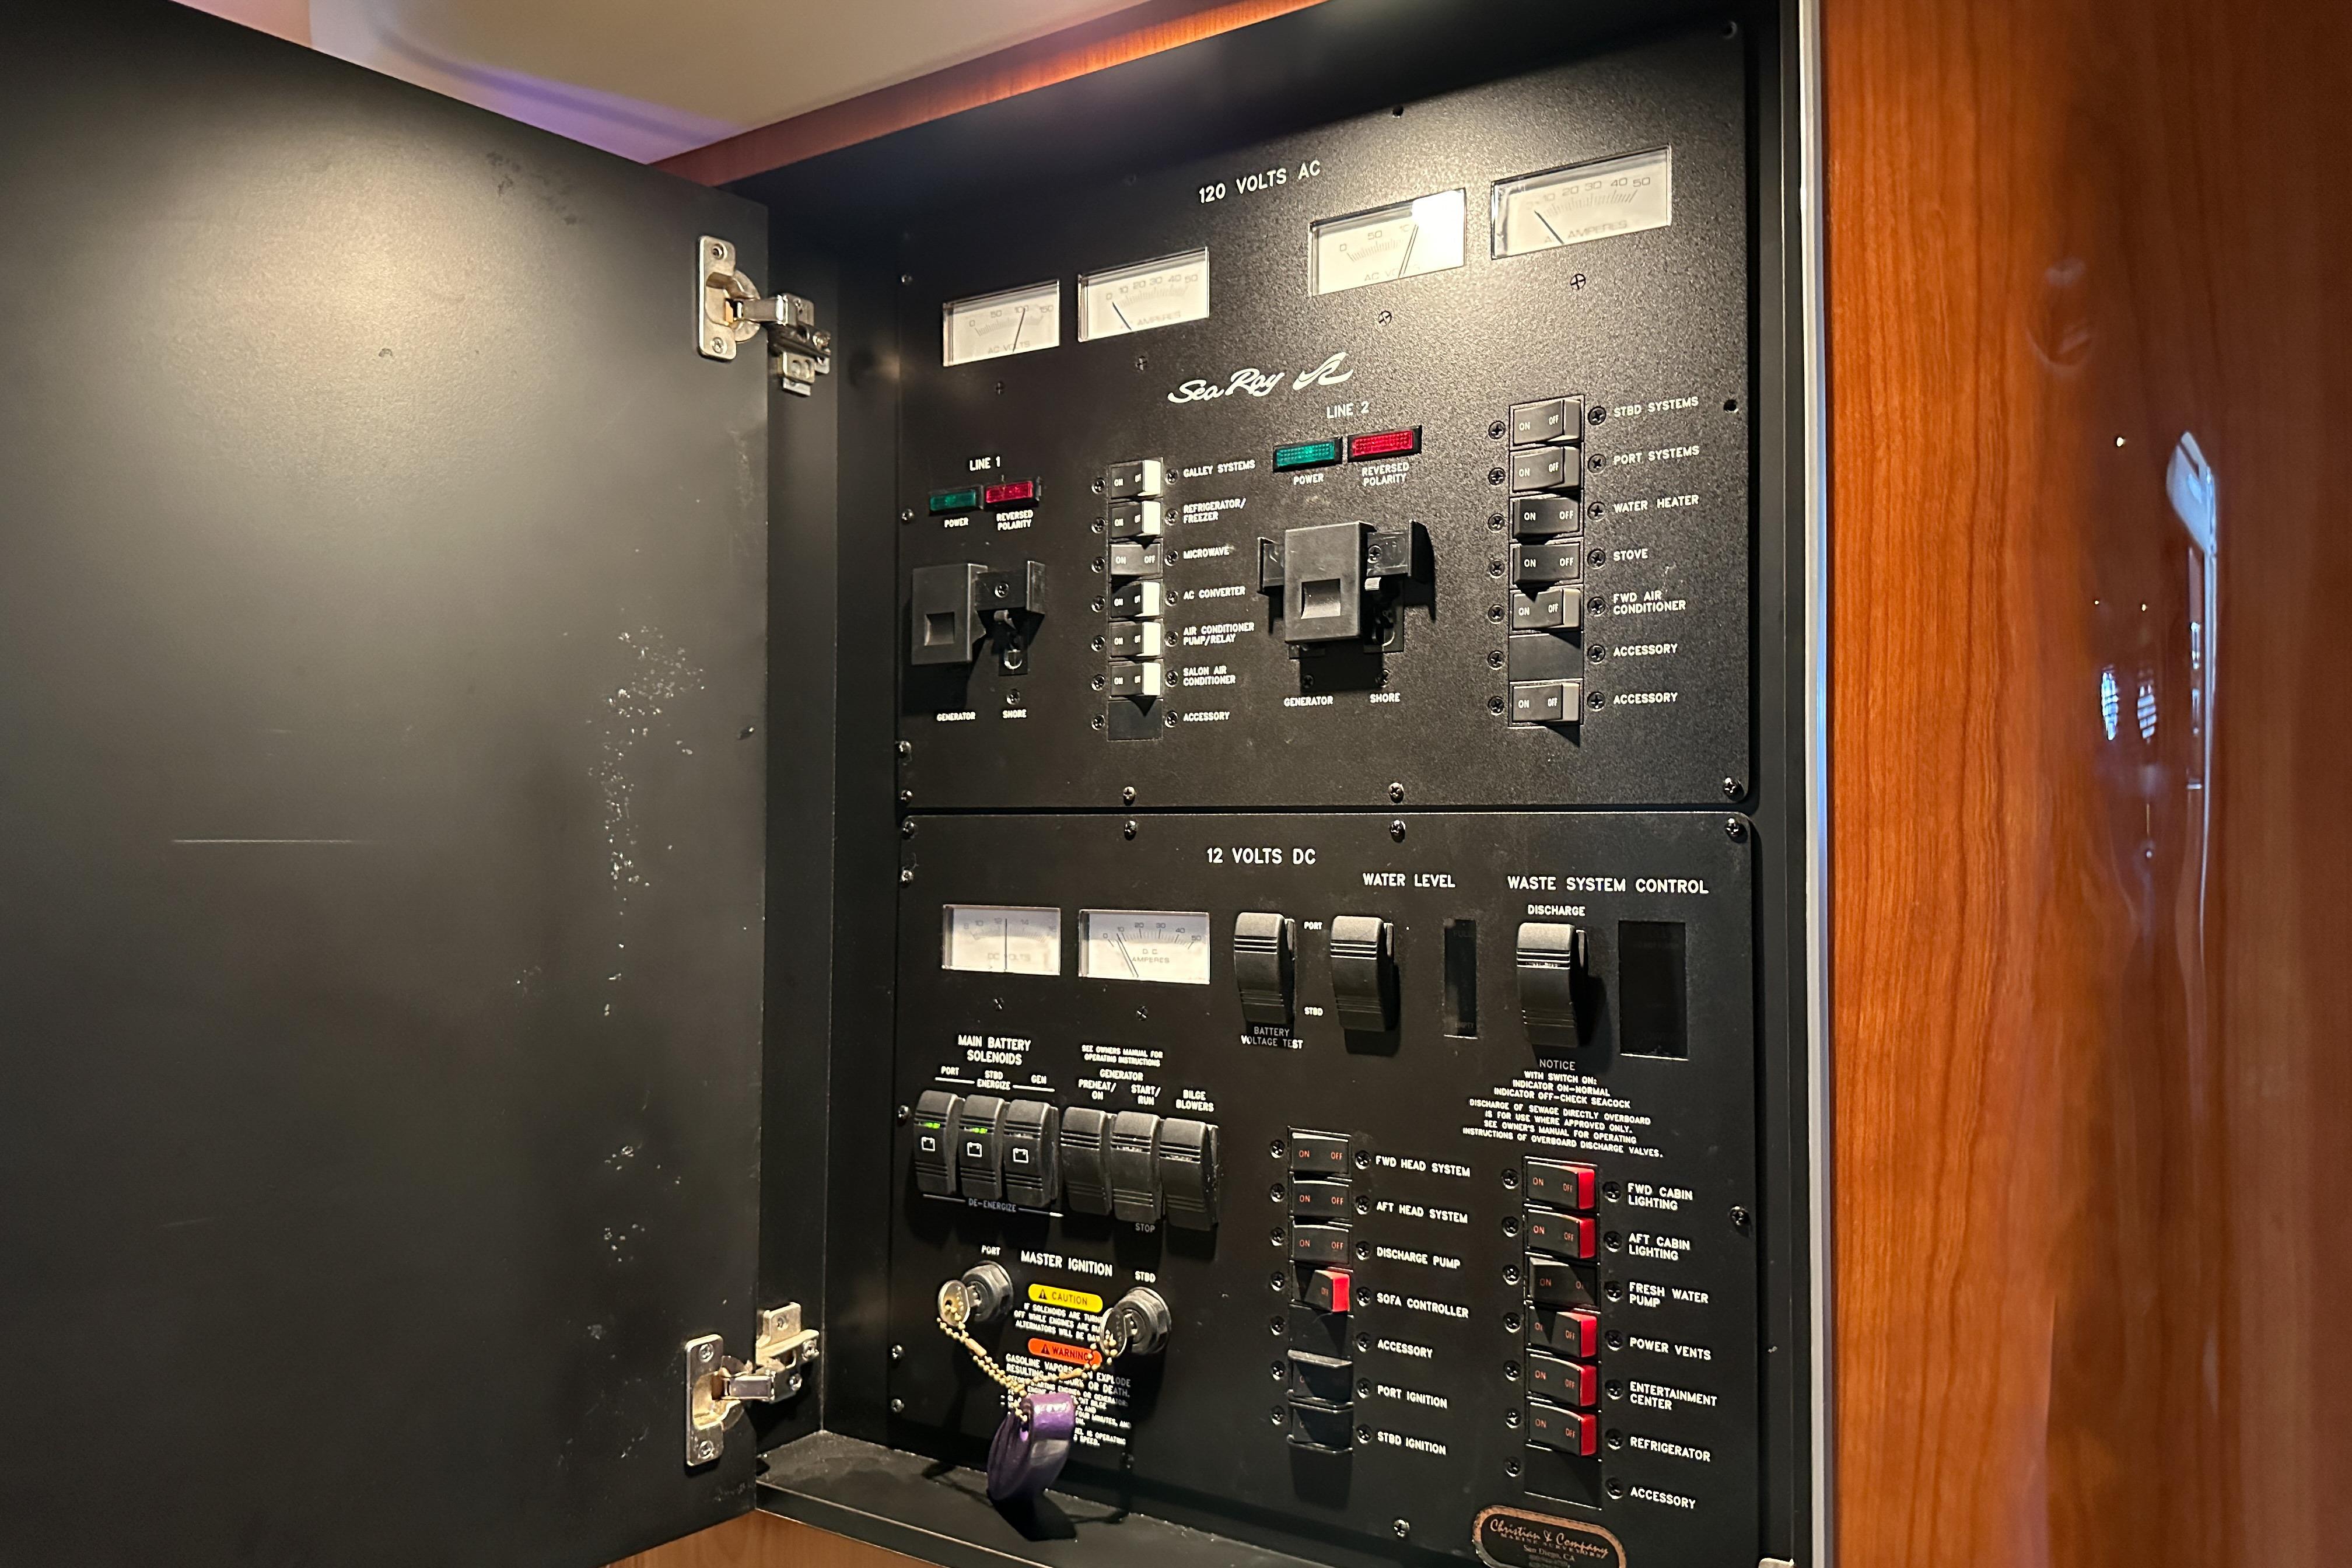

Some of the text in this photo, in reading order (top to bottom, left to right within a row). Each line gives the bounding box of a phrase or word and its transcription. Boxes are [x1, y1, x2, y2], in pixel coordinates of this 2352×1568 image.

[1199, 160, 1321, 203] 120 VOLTS AC
[1611, 177, 1650, 187] 40 50
[1168, 368, 1284, 403] Sea Ray
[1327, 402, 1369, 418] LINE 2
[1614, 397, 1699, 418] STBD SYSTEMS
[1614, 446, 1699, 466] PORT SYSTEMS
[970, 457, 1001, 471] LINE 1
[1184, 460, 1255, 478] GALLEY SYSTEMS
[1362, 463, 1409, 477] REVERSED
[1294, 474, 1324, 485] POWER
[1363, 473, 1407, 486] POLARITY
[1184, 498, 1247, 513] REFRIGERATOR/
[1614, 495, 1699, 513] WATER HEATER
[944, 518, 968, 527] POWER
[997, 510, 1033, 522] REVERSED
[1184, 511, 1219, 524] FREEZER
[1524, 510, 1573, 521] ON OFF
[998, 519, 1031, 530] POLARITY
[1184, 547, 1229, 559] MICROWAVE
[1614, 549, 1648, 561] STOVE
[1184, 586, 1245, 600] AC CONVERTER
[1614, 590, 1662, 603] FWD AIR
[1614, 600, 1686, 615] CONDITIONER
[1184, 622, 1255, 635] AIR CONDITIONER
[1184, 634, 1236, 646] PUMP/RELAY
[1614, 644, 1678, 657] ACCESSORY
[1184, 666, 1227, 676] SALON AIR
[1184, 675, 1236, 685] CONDITIONER
[1284, 696, 1334, 706] GENERATOR
[1370, 692, 1400, 704] SHORE
[1614, 692, 1678, 705] ACCESSORY
[937, 712, 975, 722] GENERATOR
[1003, 710, 1027, 718] SHORE
[1184, 712, 1230, 722] ACCESSORY
[1207, 848, 1316, 864] 12 VOLTS DC
[1363, 873, 1455, 888] WATER LEVEL
[1508, 876, 1709, 894] WASTE SYSTEM CONTROL
[1528, 905, 1585, 916] DISCHARGE
[1304, 922, 1322, 930] PORT
[1304, 1007, 1323, 1016] STBD
[1254, 1027, 1290, 1036] BATTERY
[958, 1035, 1031, 1051] MAIN BATTERY
[1241, 1035, 1303, 1049] VOLTAGE TEST
[967, 1049, 1022, 1065] SOLENOIDS
[941, 1066, 959, 1075] PORT
[1539, 1059, 1576, 1070] NOTICE
[985, 1070, 1003, 1080] STBD
[1031, 1074, 1046, 1084] GEN
[1100, 1069, 1143, 1081] GENERATOR
[1524, 1071, 1597, 1084] WITH SWITCH ON:
[977, 1079, 1010, 1090] ENERGIZE
[1079, 1079, 1116, 1093] PREHEAT/
[1131, 1084, 1161, 1097] START/
[1513, 1079, 1610, 1097] INDICATOR ON-NORMAL
[1092, 1091, 1103, 1100] ON
[1138, 1096, 1154, 1105] RUN
[1183, 1090, 1206, 1100] BILGE
[1494, 1087, 1630, 1108] INDICATOR OFF-CHECK SEACOCK
[1176, 1099, 1214, 1112] BLOWERS
[1469, 1099, 1509, 1110] DISCHARGE
[1529, 1105, 1559, 1115] SEWAGE
[1563, 1108, 1598, 1119] DIRECTLY
[1604, 1112, 1651, 1125] OVERBOARD
[1497, 1112, 1511, 1120] FOR
[1516, 1113, 1530, 1122] USE
[1534, 1115, 1560, 1125] WHERE
[1564, 1119, 1605, 1130] APPROVED
[1609, 1124, 1632, 1133] ONLY.
[1484, 1120, 1636, 1144] SEE OWNER'S MANUAL FOR OPERATING
[1463, 1128, 1513, 1140] INSTRUCTIONS
[1531, 1136, 1577, 1147] OVERBOARD
[1580, 1141, 1623, 1153] DISCHARGE
[1629, 1146, 1663, 1157] VALVES.
[1299, 1150, 1343, 1160] ON OFF
[1376, 1156, 1470, 1177] FWD HEAD SYSTEM
[1628, 1183, 1693, 1201] FWD CABIN
[968, 1198, 1016, 1212] DE-ENERGIZE
[1628, 1195, 1678, 1210] LIGHTING
[1377, 1202, 1468, 1223] AFT HEAD SYSTEM
[1136, 1223, 1154, 1233] STOP
[1629, 1233, 1690, 1251] AFT CABIN
[981, 1245, 1000, 1255] PORT
[1629, 1244, 1679, 1261] LIGHTING
[1021, 1251, 1112, 1276] MASTER IGNITION
[1377, 1247, 1460, 1269] DISCHARGE PUMP
[1135, 1271, 1156, 1283] STBD
[1052, 1292, 1087, 1306] CAUTION
[1629, 1282, 1709, 1304] FRESH WATER
[1377, 1293, 1469, 1318] SOFA CONTROLLER
[1630, 1294, 1660, 1308] PUMP
[1377, 1340, 1433, 1359] ACCESSORY
[1630, 1338, 1712, 1361] POWER VENTS
[1377, 1385, 1447, 1409] PORT IGNITION
[1630, 1382, 1717, 1406] ENTERTAINMENT
[1630, 1395, 1672, 1410] CENTER
[1378, 1432, 1446, 1455] STBD IGNITION
[1630, 1437, 1710, 1462] REFRIGERATOR
[1630, 1488, 1696, 1509] ACCESSORY
[1490, 1519, 1540, 1539] Christian
